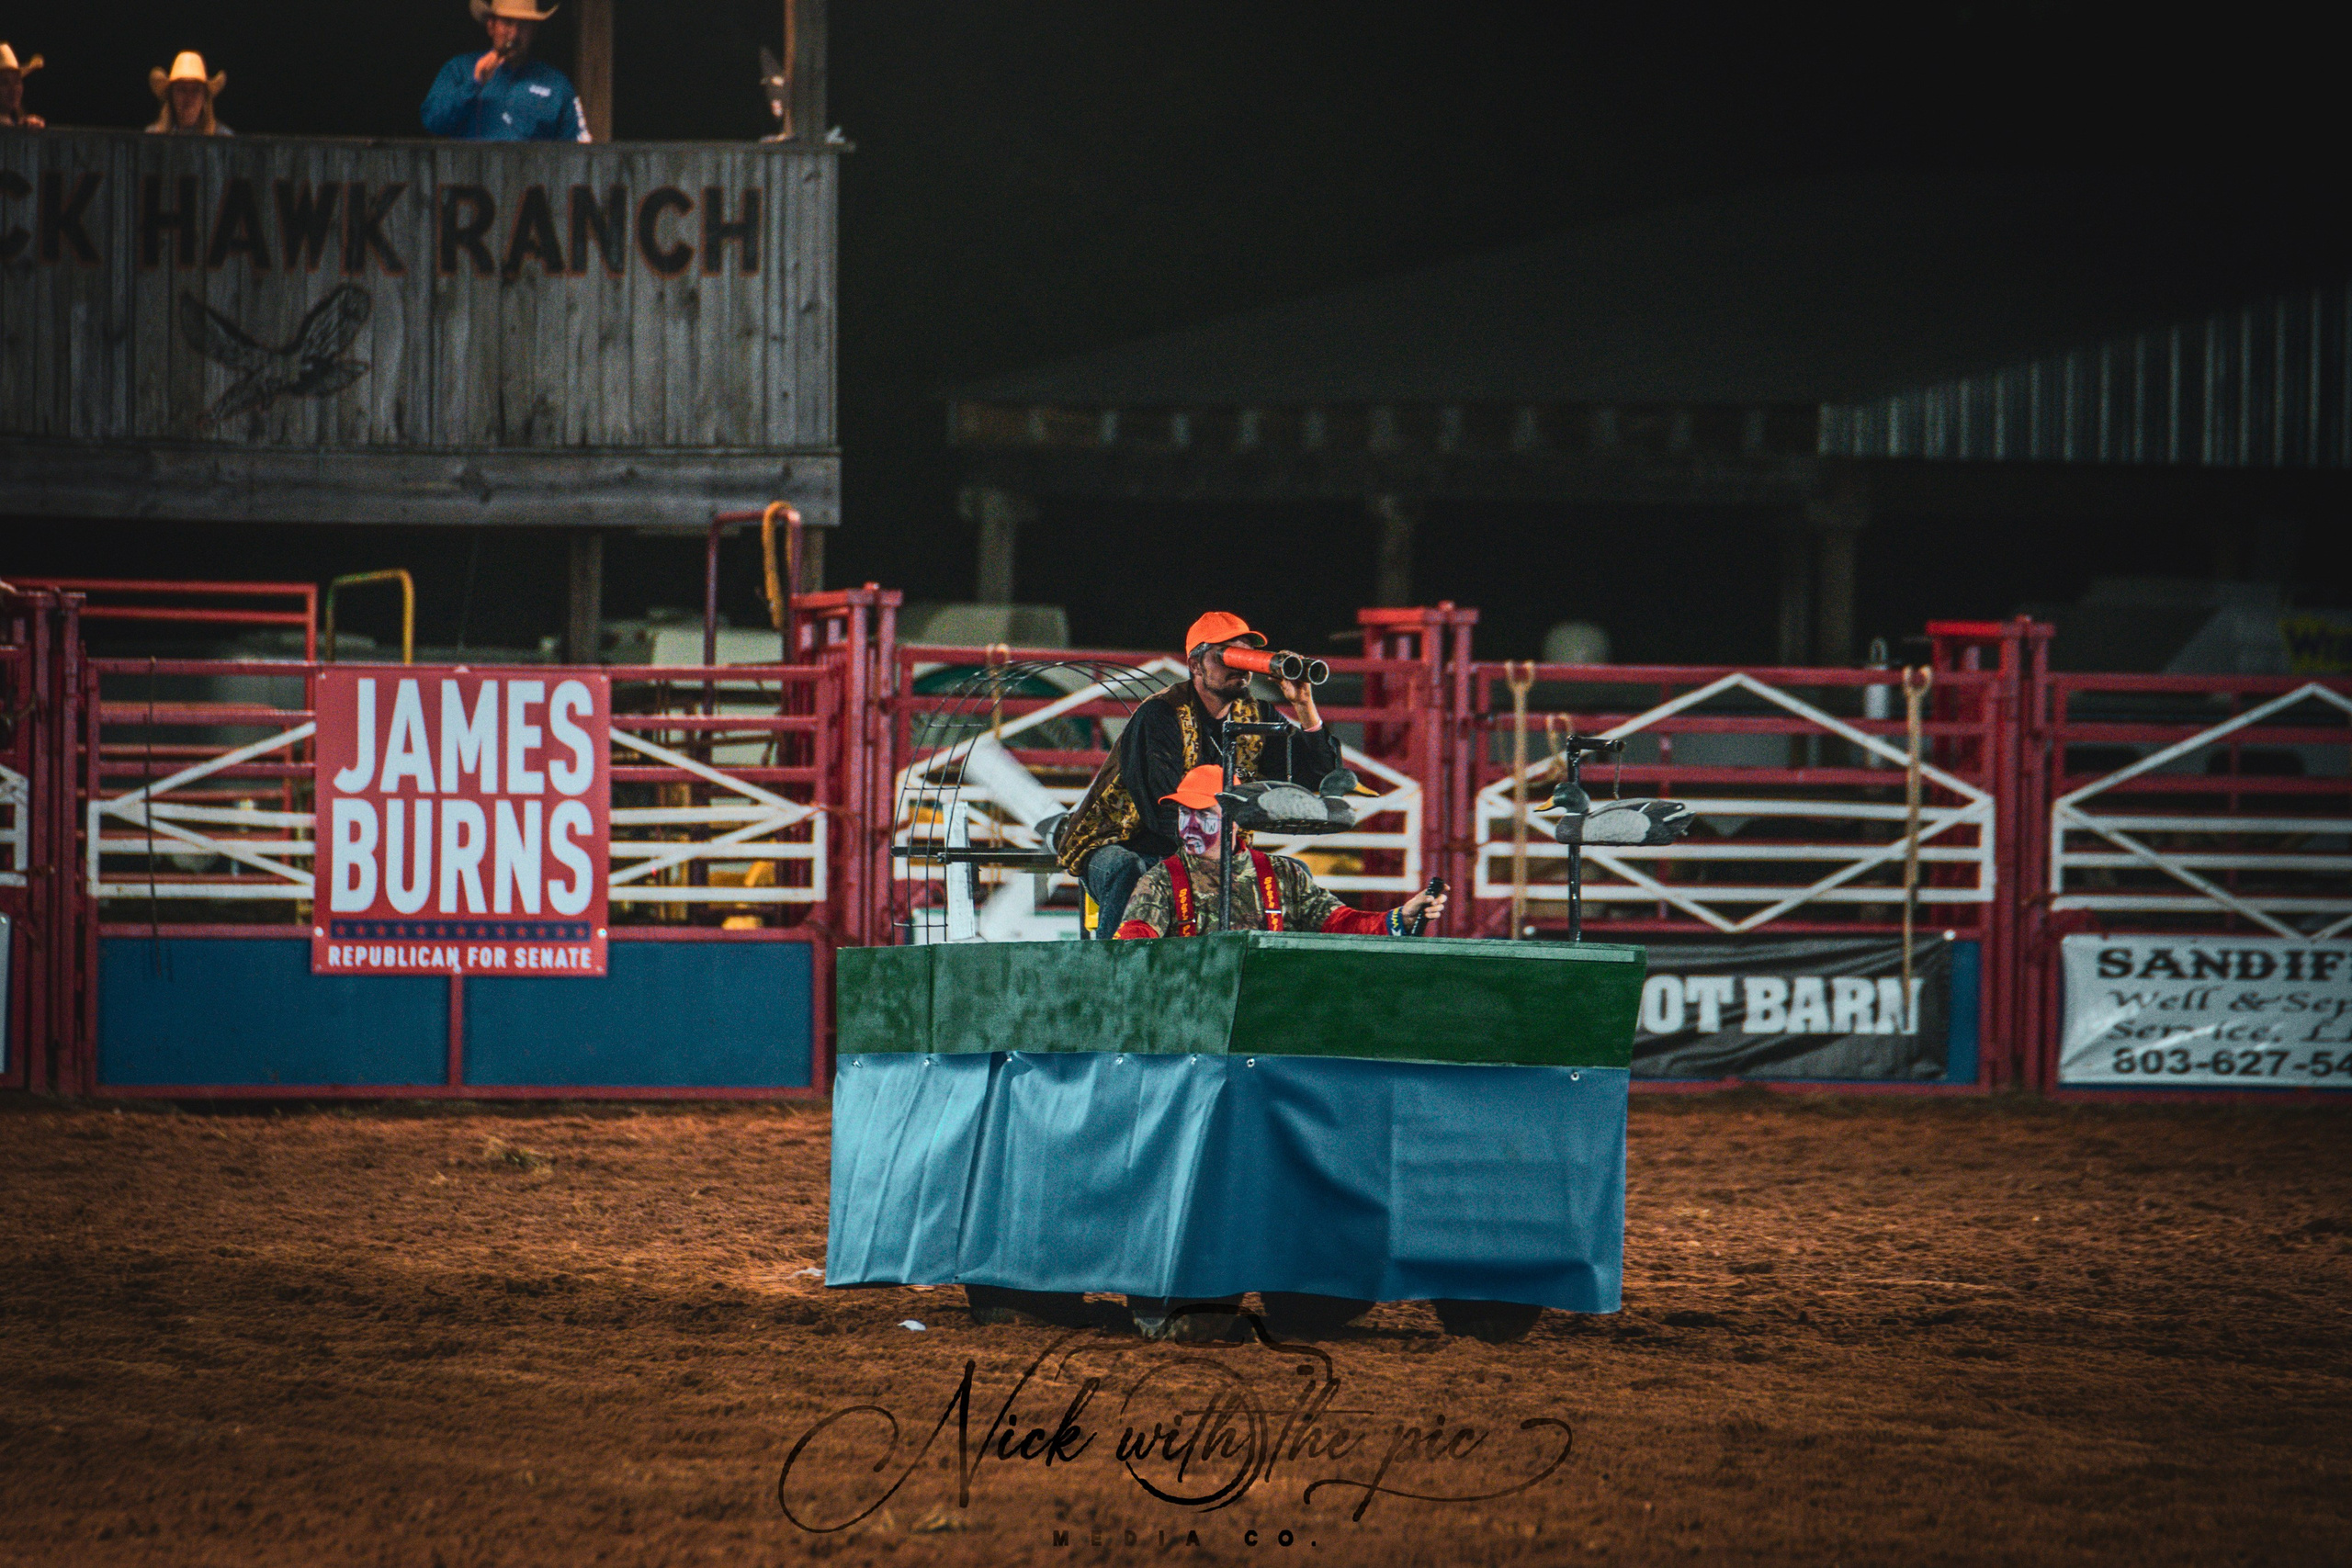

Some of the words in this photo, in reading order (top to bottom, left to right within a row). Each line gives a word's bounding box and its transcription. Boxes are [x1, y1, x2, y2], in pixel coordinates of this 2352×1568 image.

[138, 175, 410, 276] HAWK
[435, 183, 763, 278] RANCH
[333, 677, 595, 795] JAMES
[330, 797, 594, 916] BURNS
[327, 945, 460, 967] REPUBLICAN
[467, 946, 507, 967] FOR
[514, 947, 593, 969] SENATE
[2097, 948, 2352, 981] SANDIF
[1636, 974, 1735, 1034] OT
[1742, 976, 1925, 1035] BARN
[2106, 986, 2223, 1011] Well
[2228, 992, 2281, 1012] &
